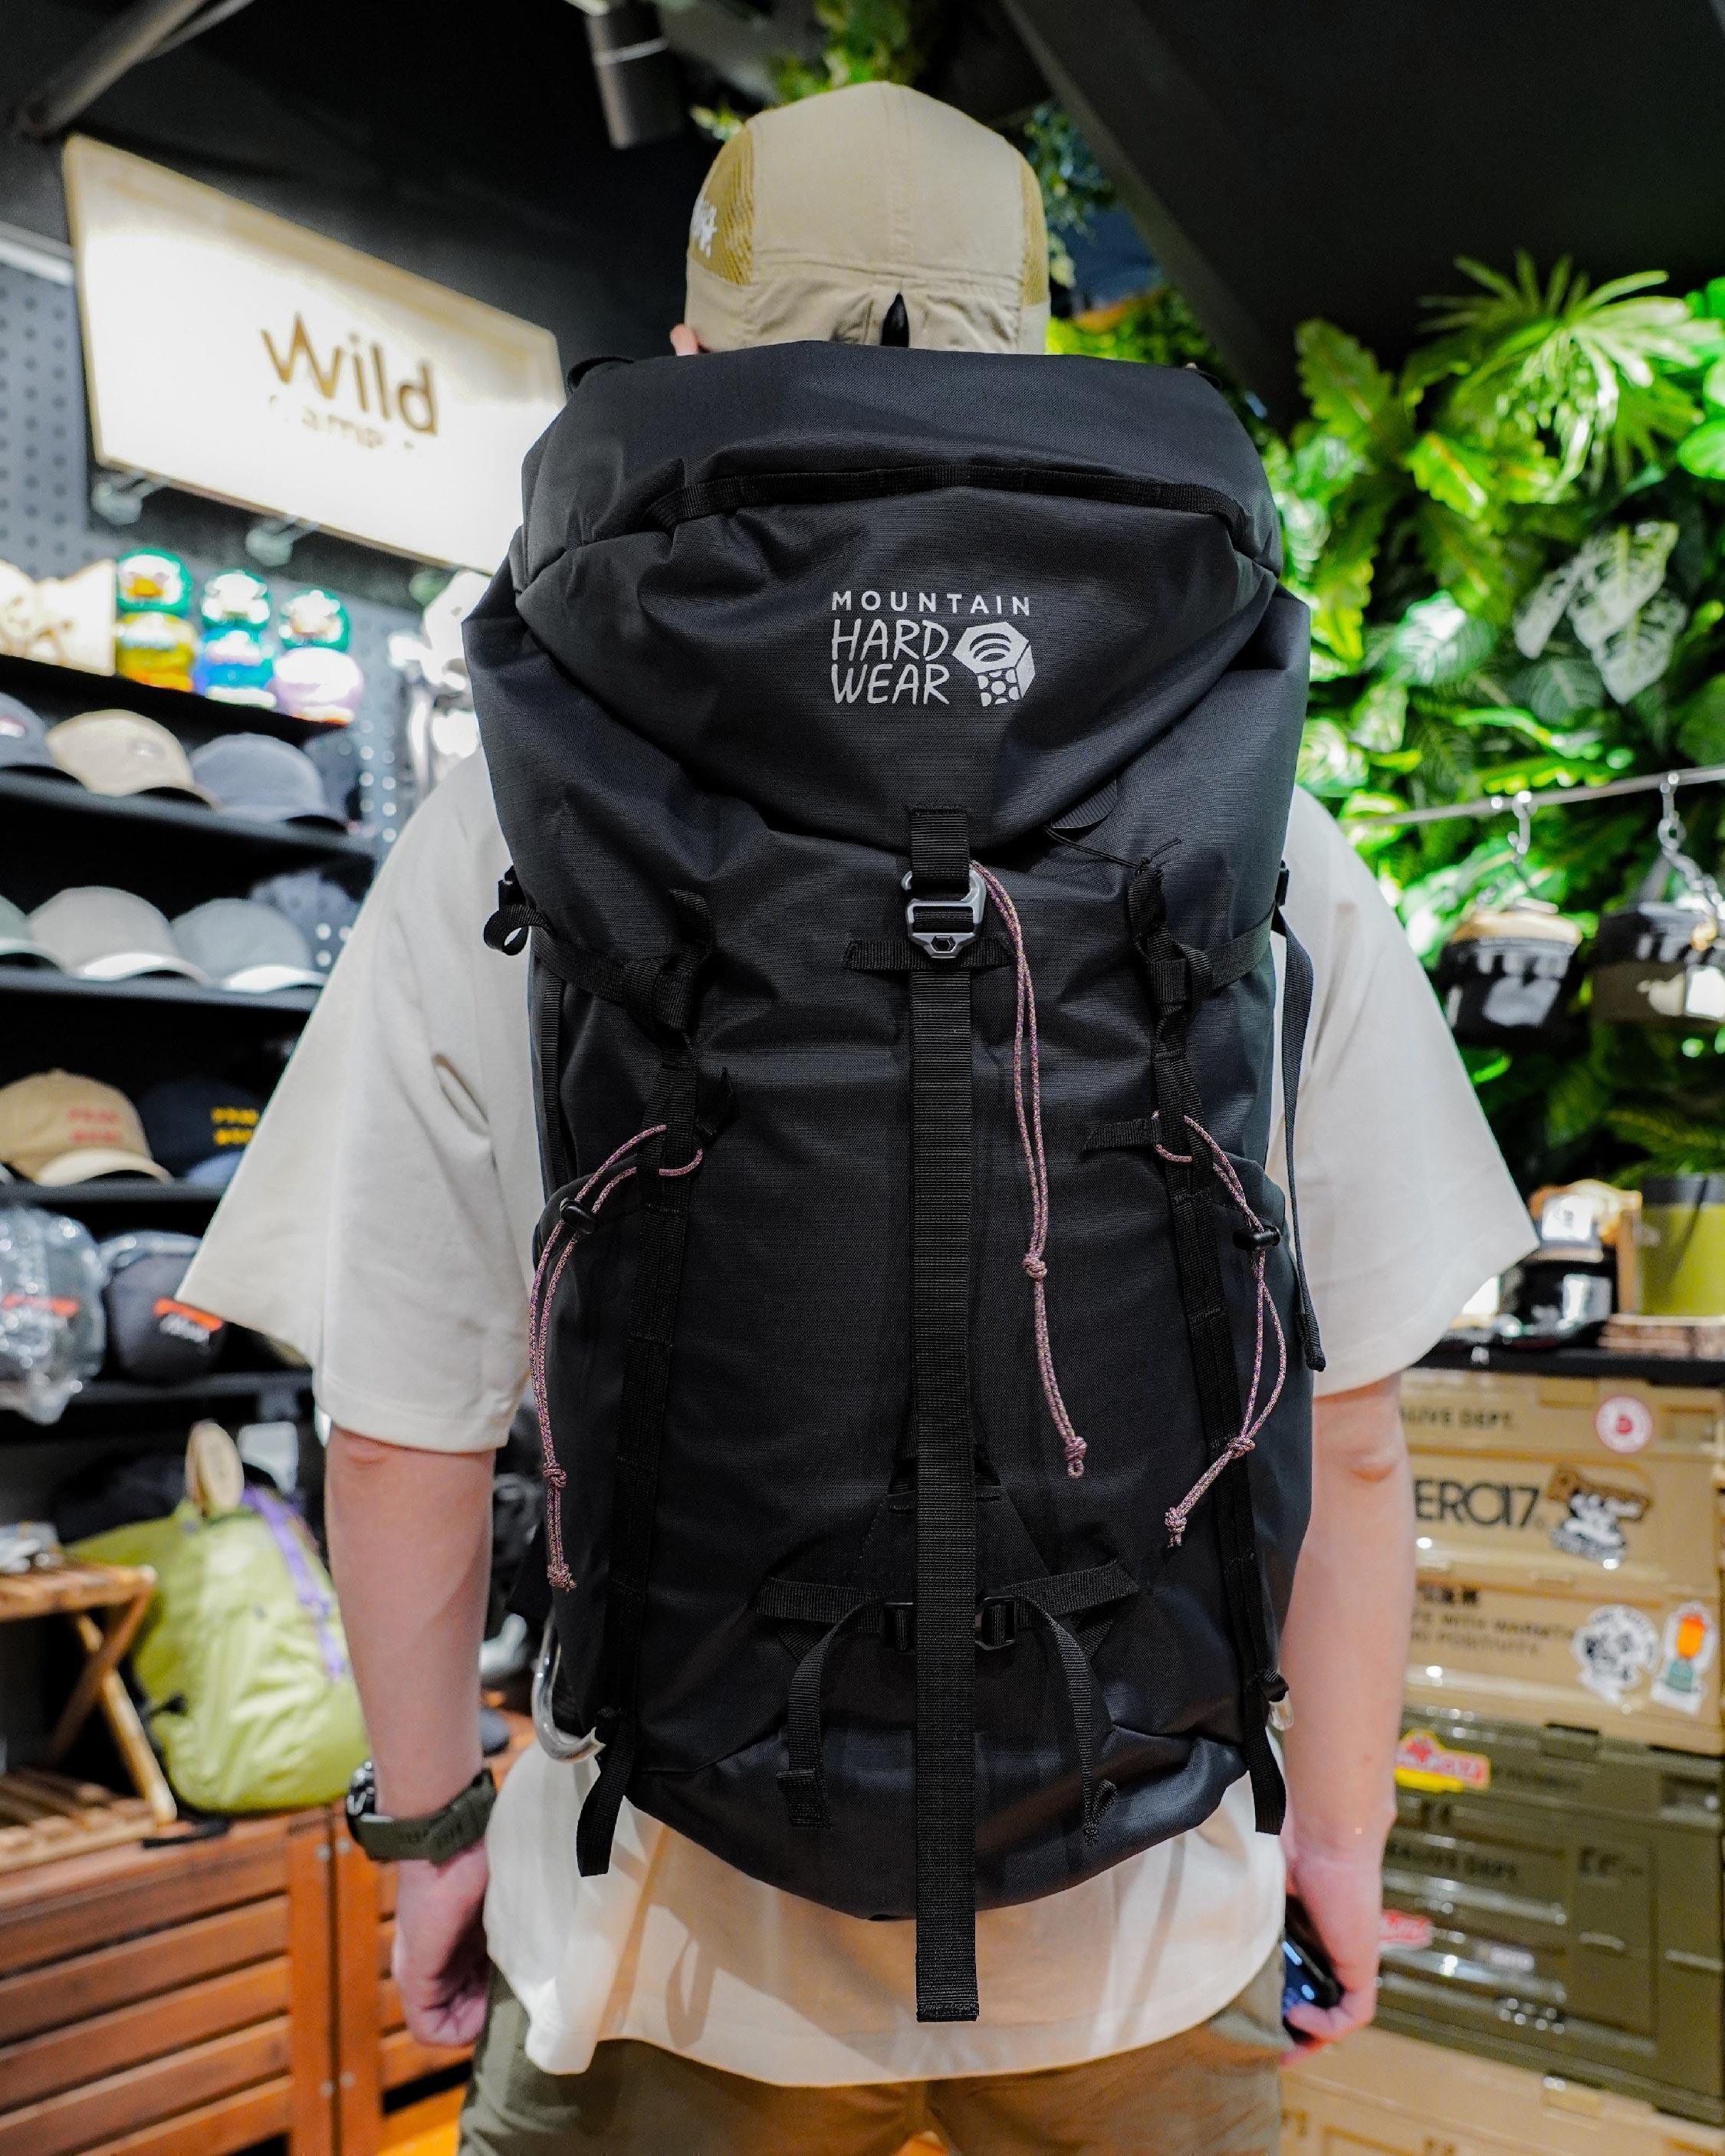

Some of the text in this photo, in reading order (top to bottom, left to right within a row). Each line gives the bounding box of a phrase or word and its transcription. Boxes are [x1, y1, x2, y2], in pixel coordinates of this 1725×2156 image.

[260, 311, 438, 437] Wild
[831, 590, 1030, 616] MOUNTAIN
[831, 618, 950, 662] HARD
[831, 663, 951, 705] WEAR
